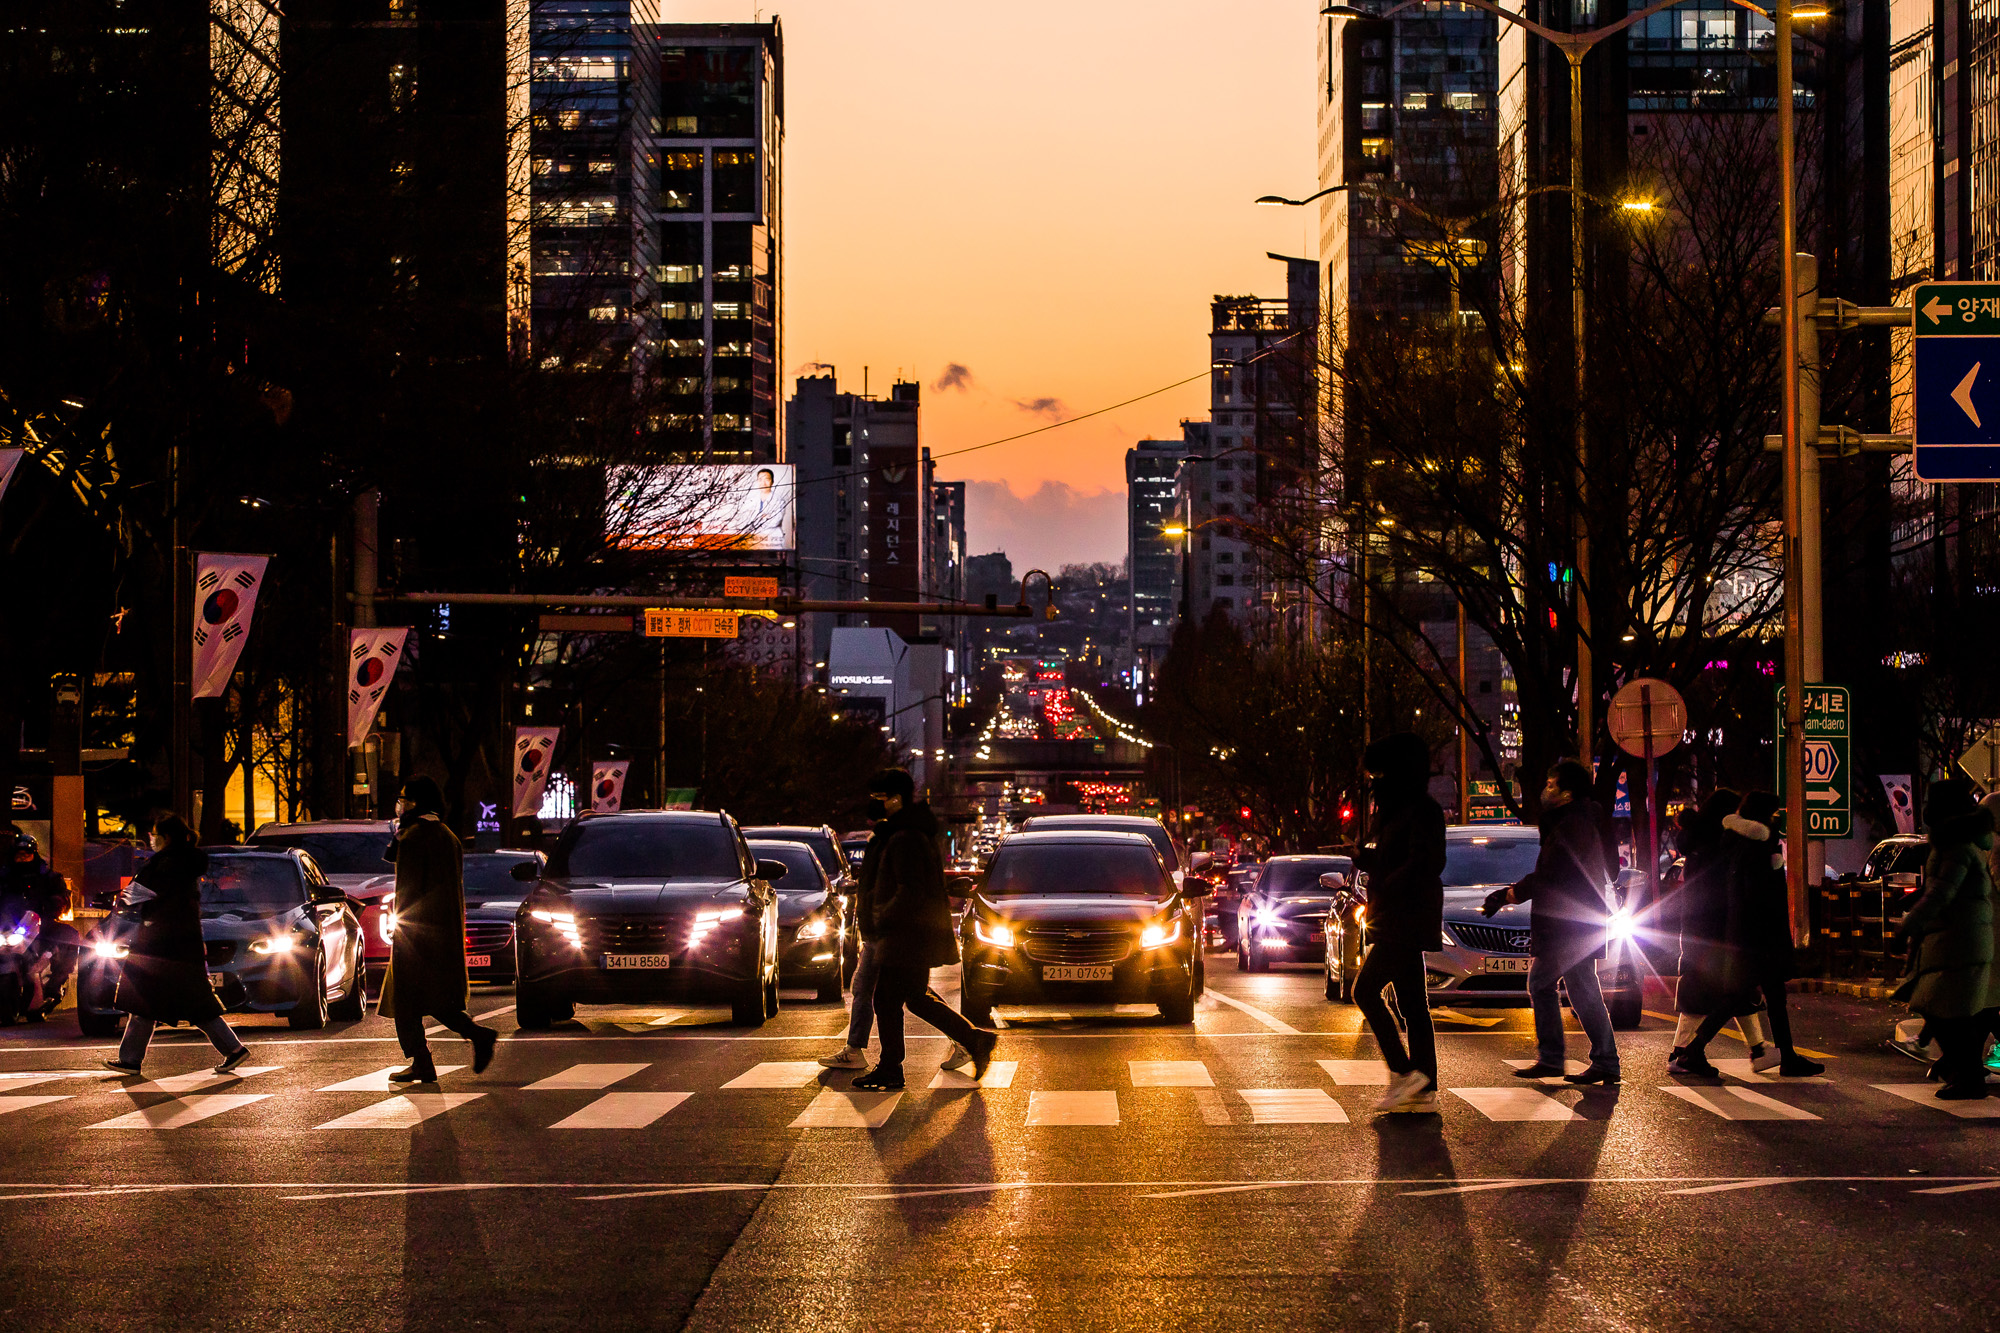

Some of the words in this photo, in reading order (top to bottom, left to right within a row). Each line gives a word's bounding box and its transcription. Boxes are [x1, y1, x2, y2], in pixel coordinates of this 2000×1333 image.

[1958, 297, 2000, 323] 양재
[886, 502, 899, 564] 레지던스
[726, 586, 750, 595] CCTV
[650, 616, 663, 633] 불법
[692, 617, 713, 632] CCTV
[714, 617, 734, 634] 단속중
[1478, 784, 1500, 794] 강남
[849, 850, 865, 859] 740
[468, 956, 489, 966] 4619
[639, 956, 668, 968] 8586
[1077, 967, 1107, 979] 0769
